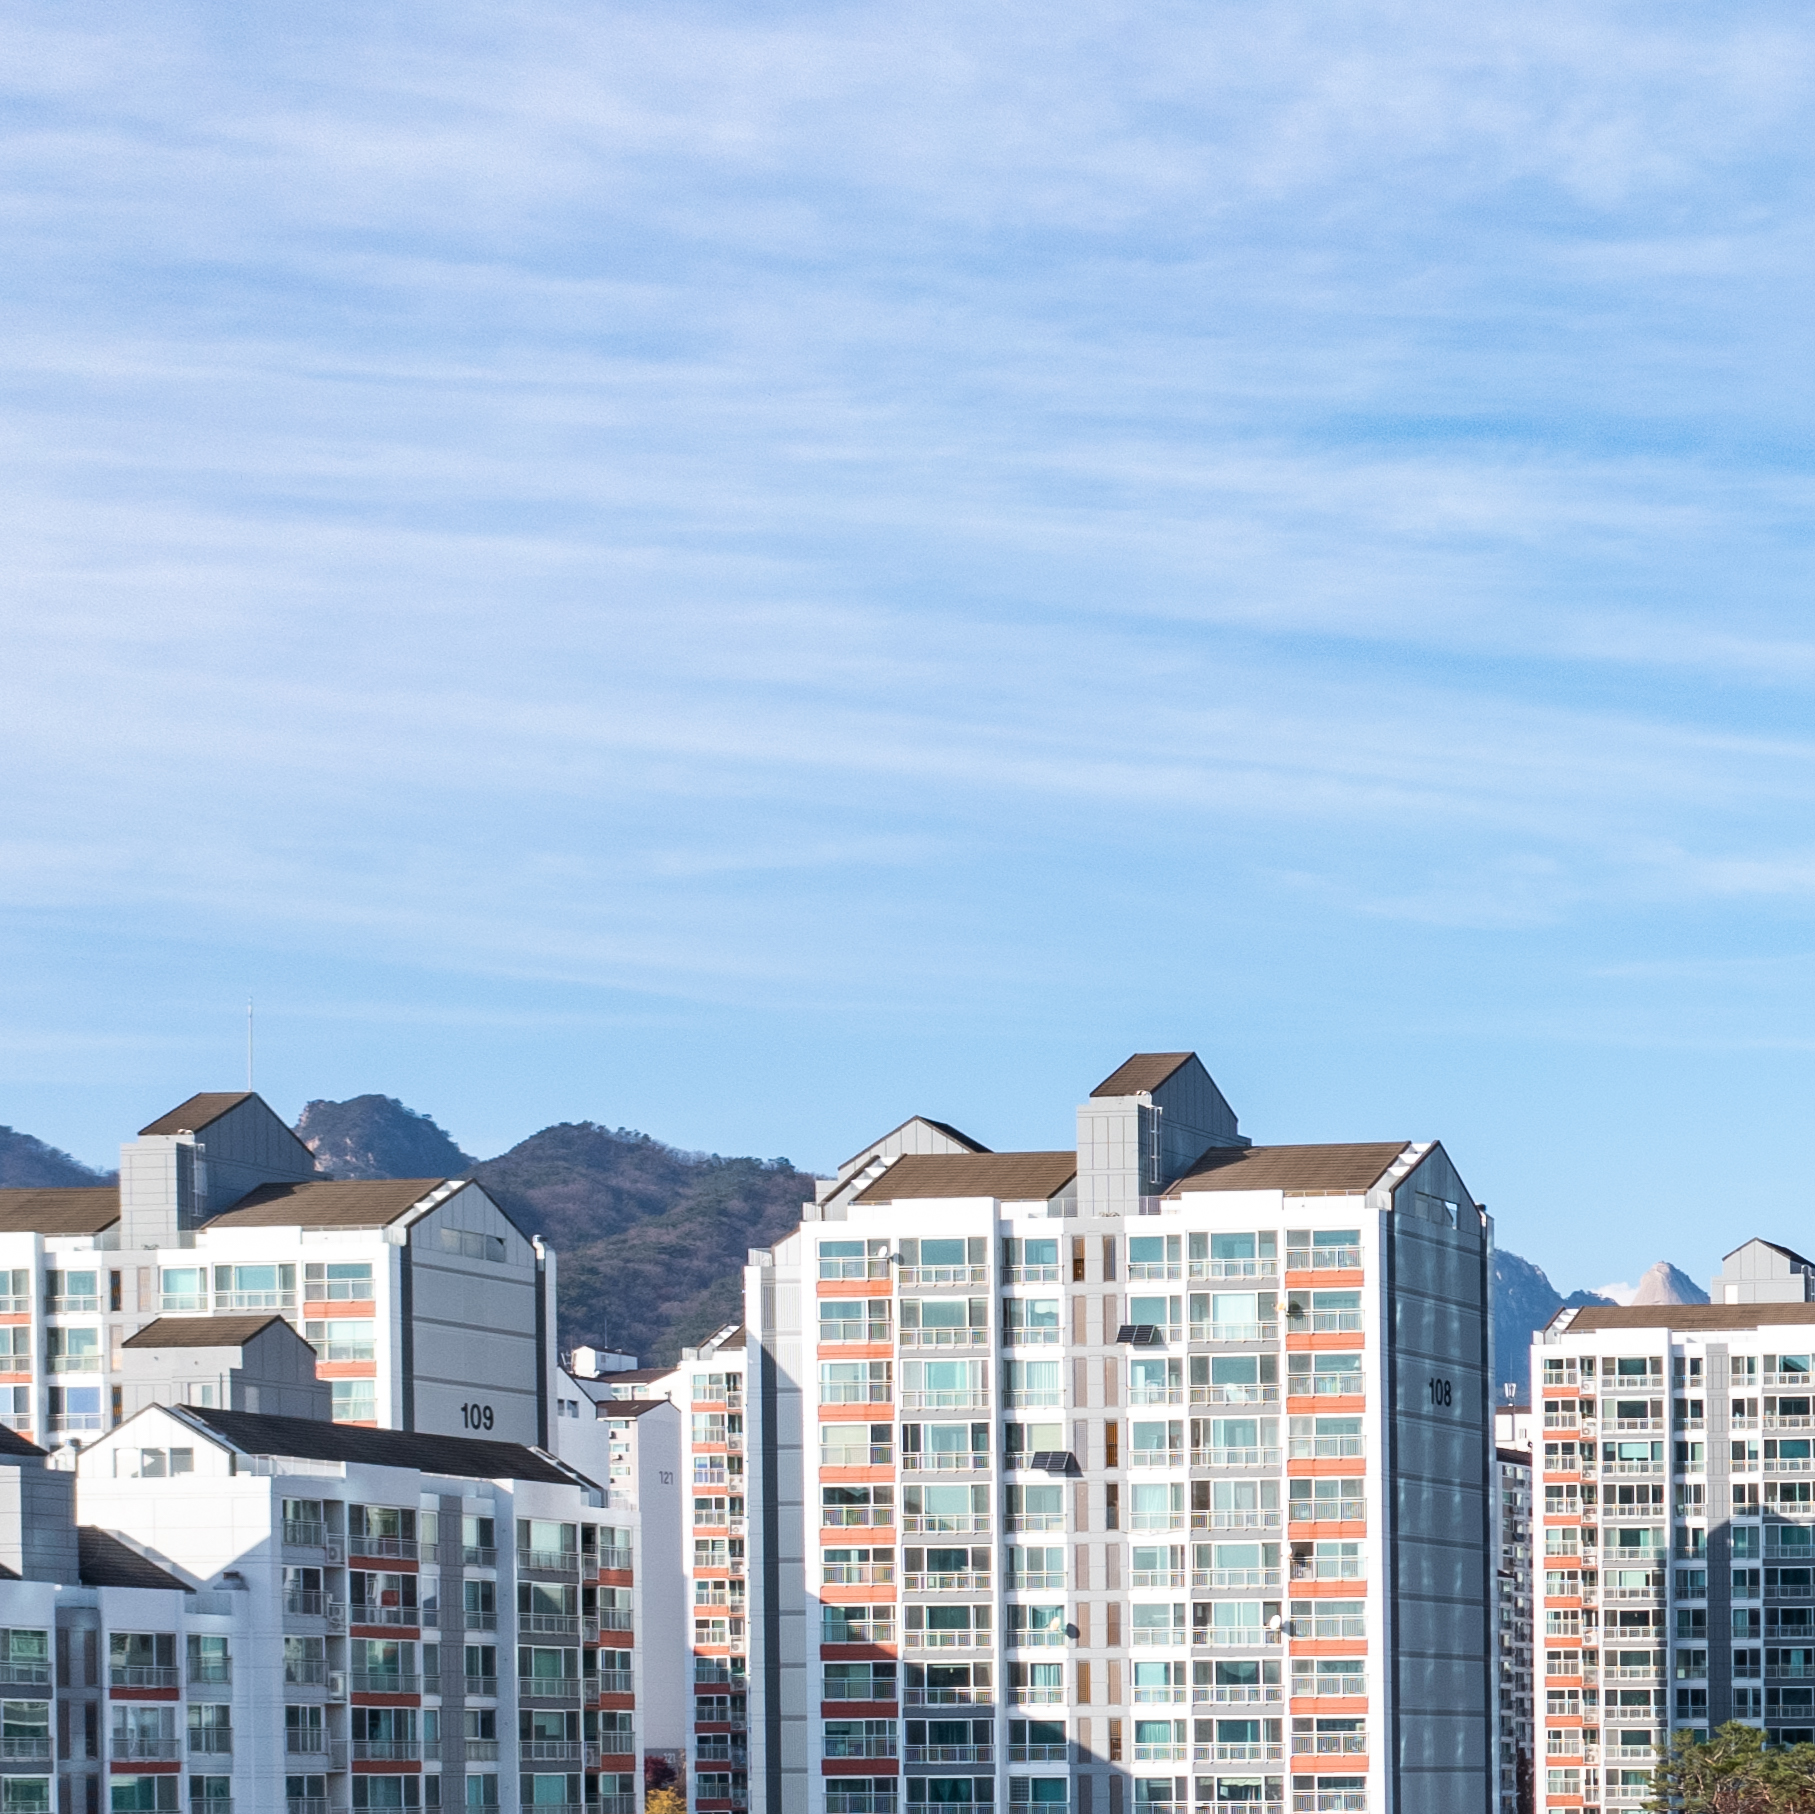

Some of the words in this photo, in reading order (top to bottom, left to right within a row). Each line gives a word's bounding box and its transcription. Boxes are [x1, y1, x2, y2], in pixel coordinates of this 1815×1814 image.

[1429, 1377, 1451, 1406] 108
[461, 1402, 494, 1430] 109
[658, 1471, 673, 1485] 121
